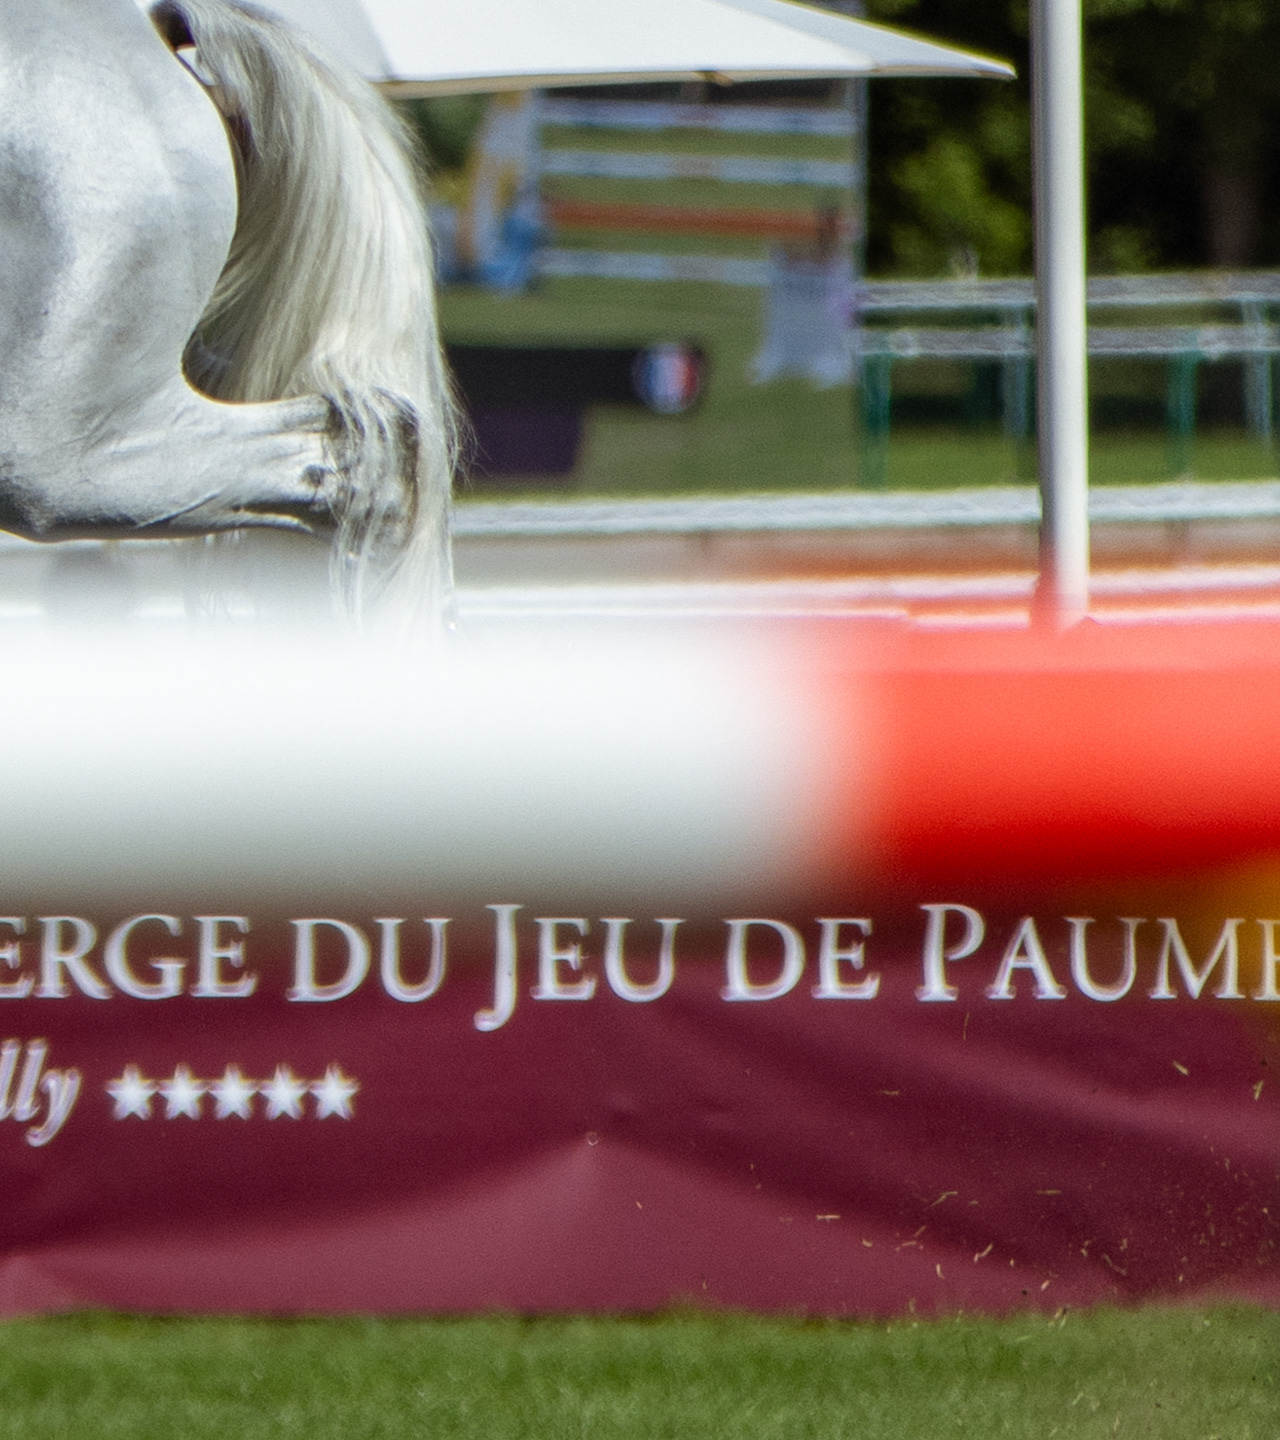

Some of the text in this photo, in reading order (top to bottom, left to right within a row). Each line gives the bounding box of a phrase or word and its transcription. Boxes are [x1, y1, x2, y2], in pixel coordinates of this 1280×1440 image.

[288, 918, 452, 1002] DU
[474, 903, 686, 1031] JEU
[721, 918, 880, 1001] DE
